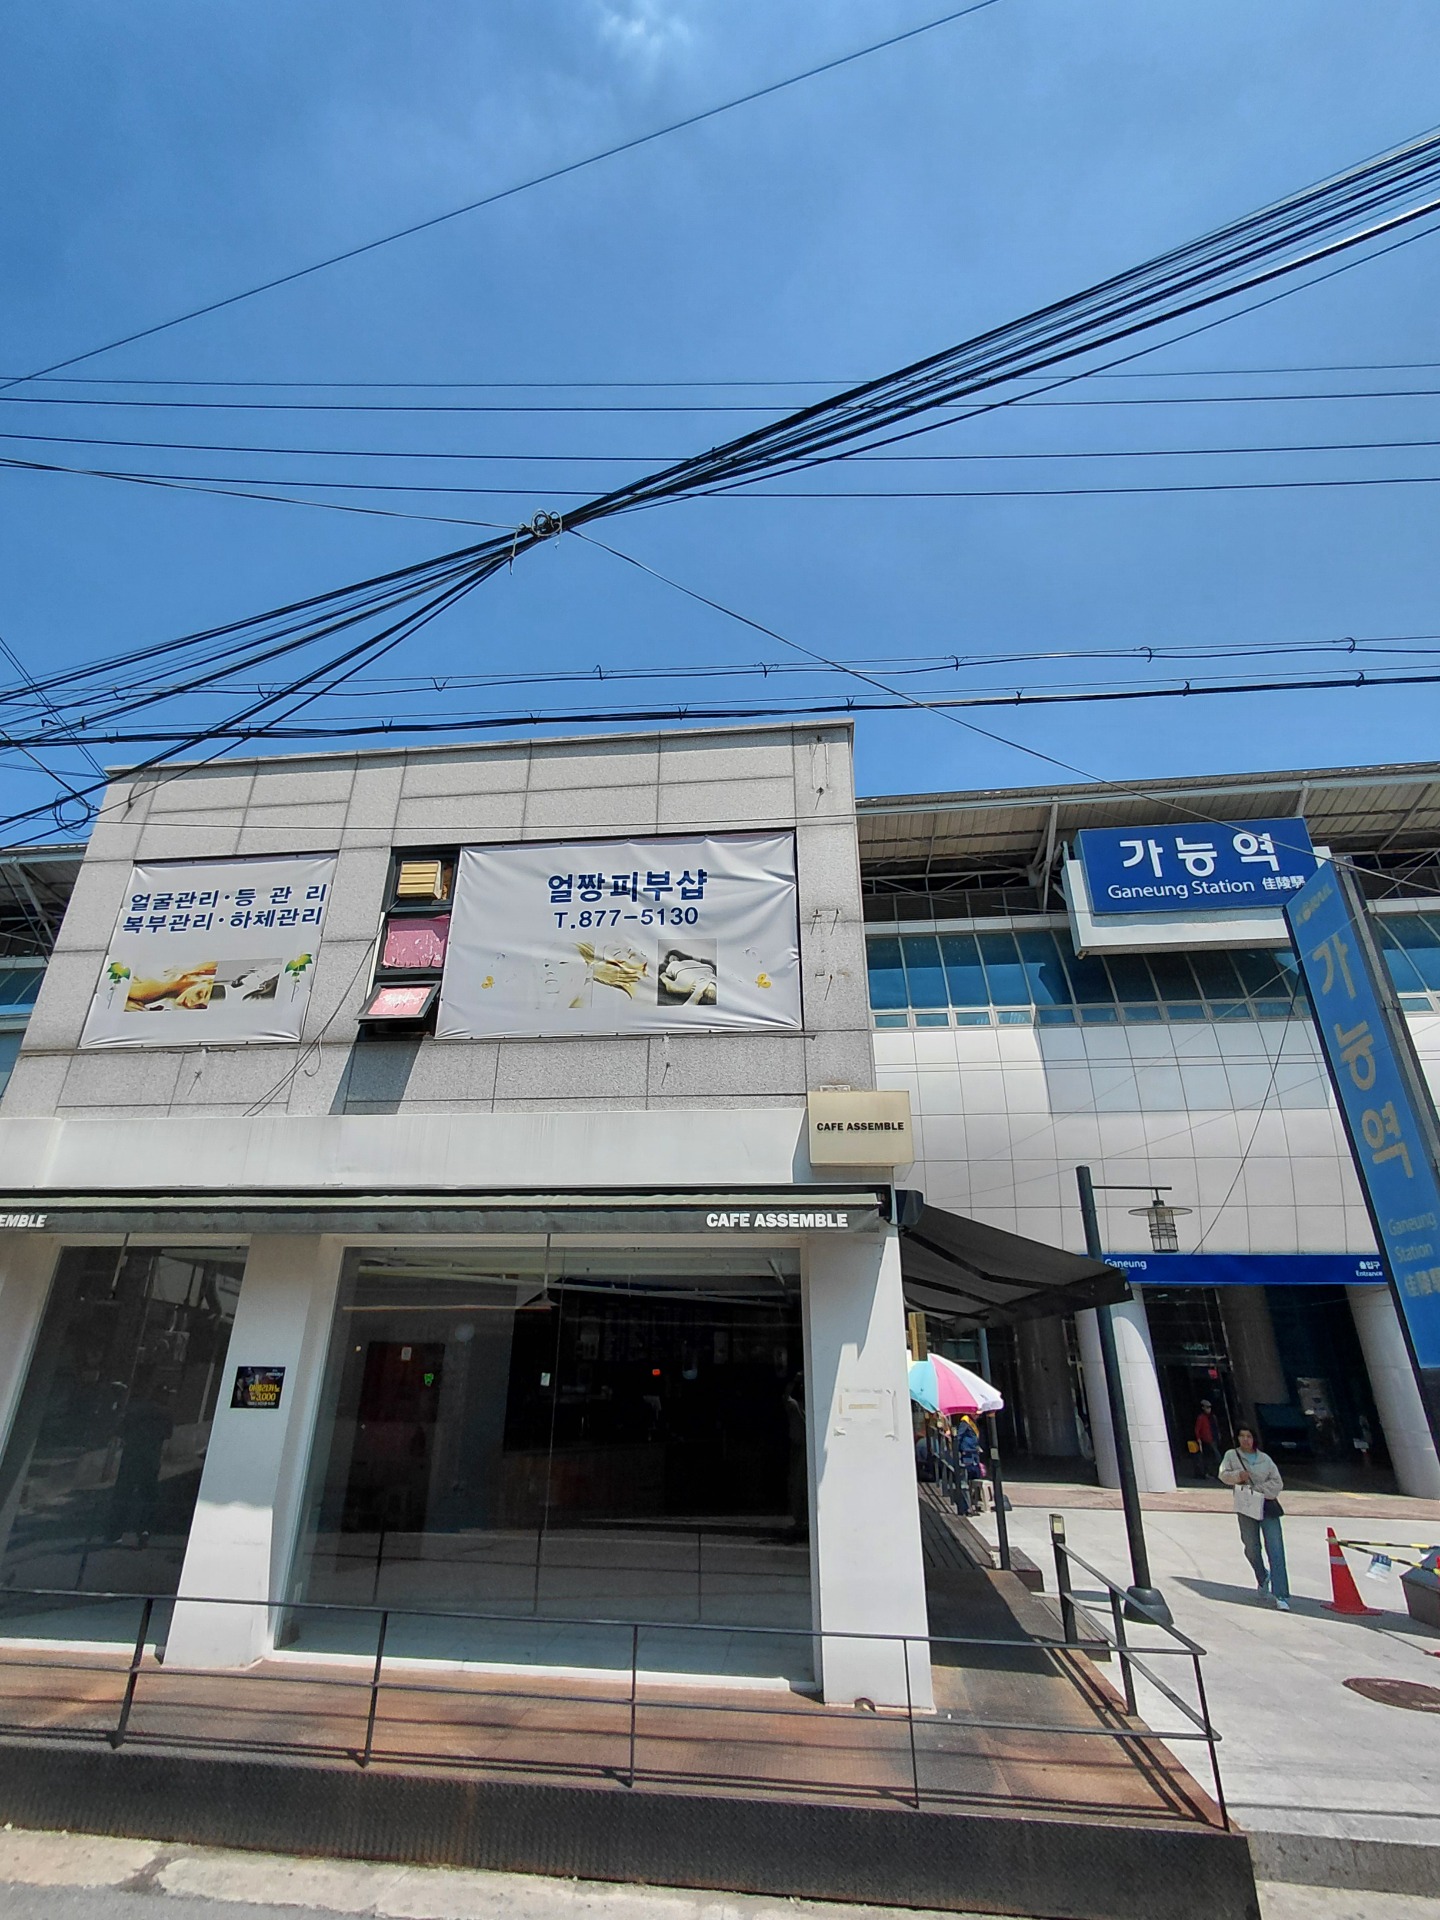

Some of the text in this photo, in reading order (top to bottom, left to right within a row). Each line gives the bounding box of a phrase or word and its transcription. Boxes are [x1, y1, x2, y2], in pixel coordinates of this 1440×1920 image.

[548, 868, 709, 904] 얼짱피부샵
[1107, 878, 1256, 900] Ganeung Station
[553, 906, 700, 931] T.877-5130
[816, 1121, 905, 1132] CAFE ASSEMBLE
[0, 1213, 48, 1228] EMBLE
[706, 1213, 849, 1228] CAFE ASSEMBLE
[1104, 1258, 1148, 1270] Ganeung
